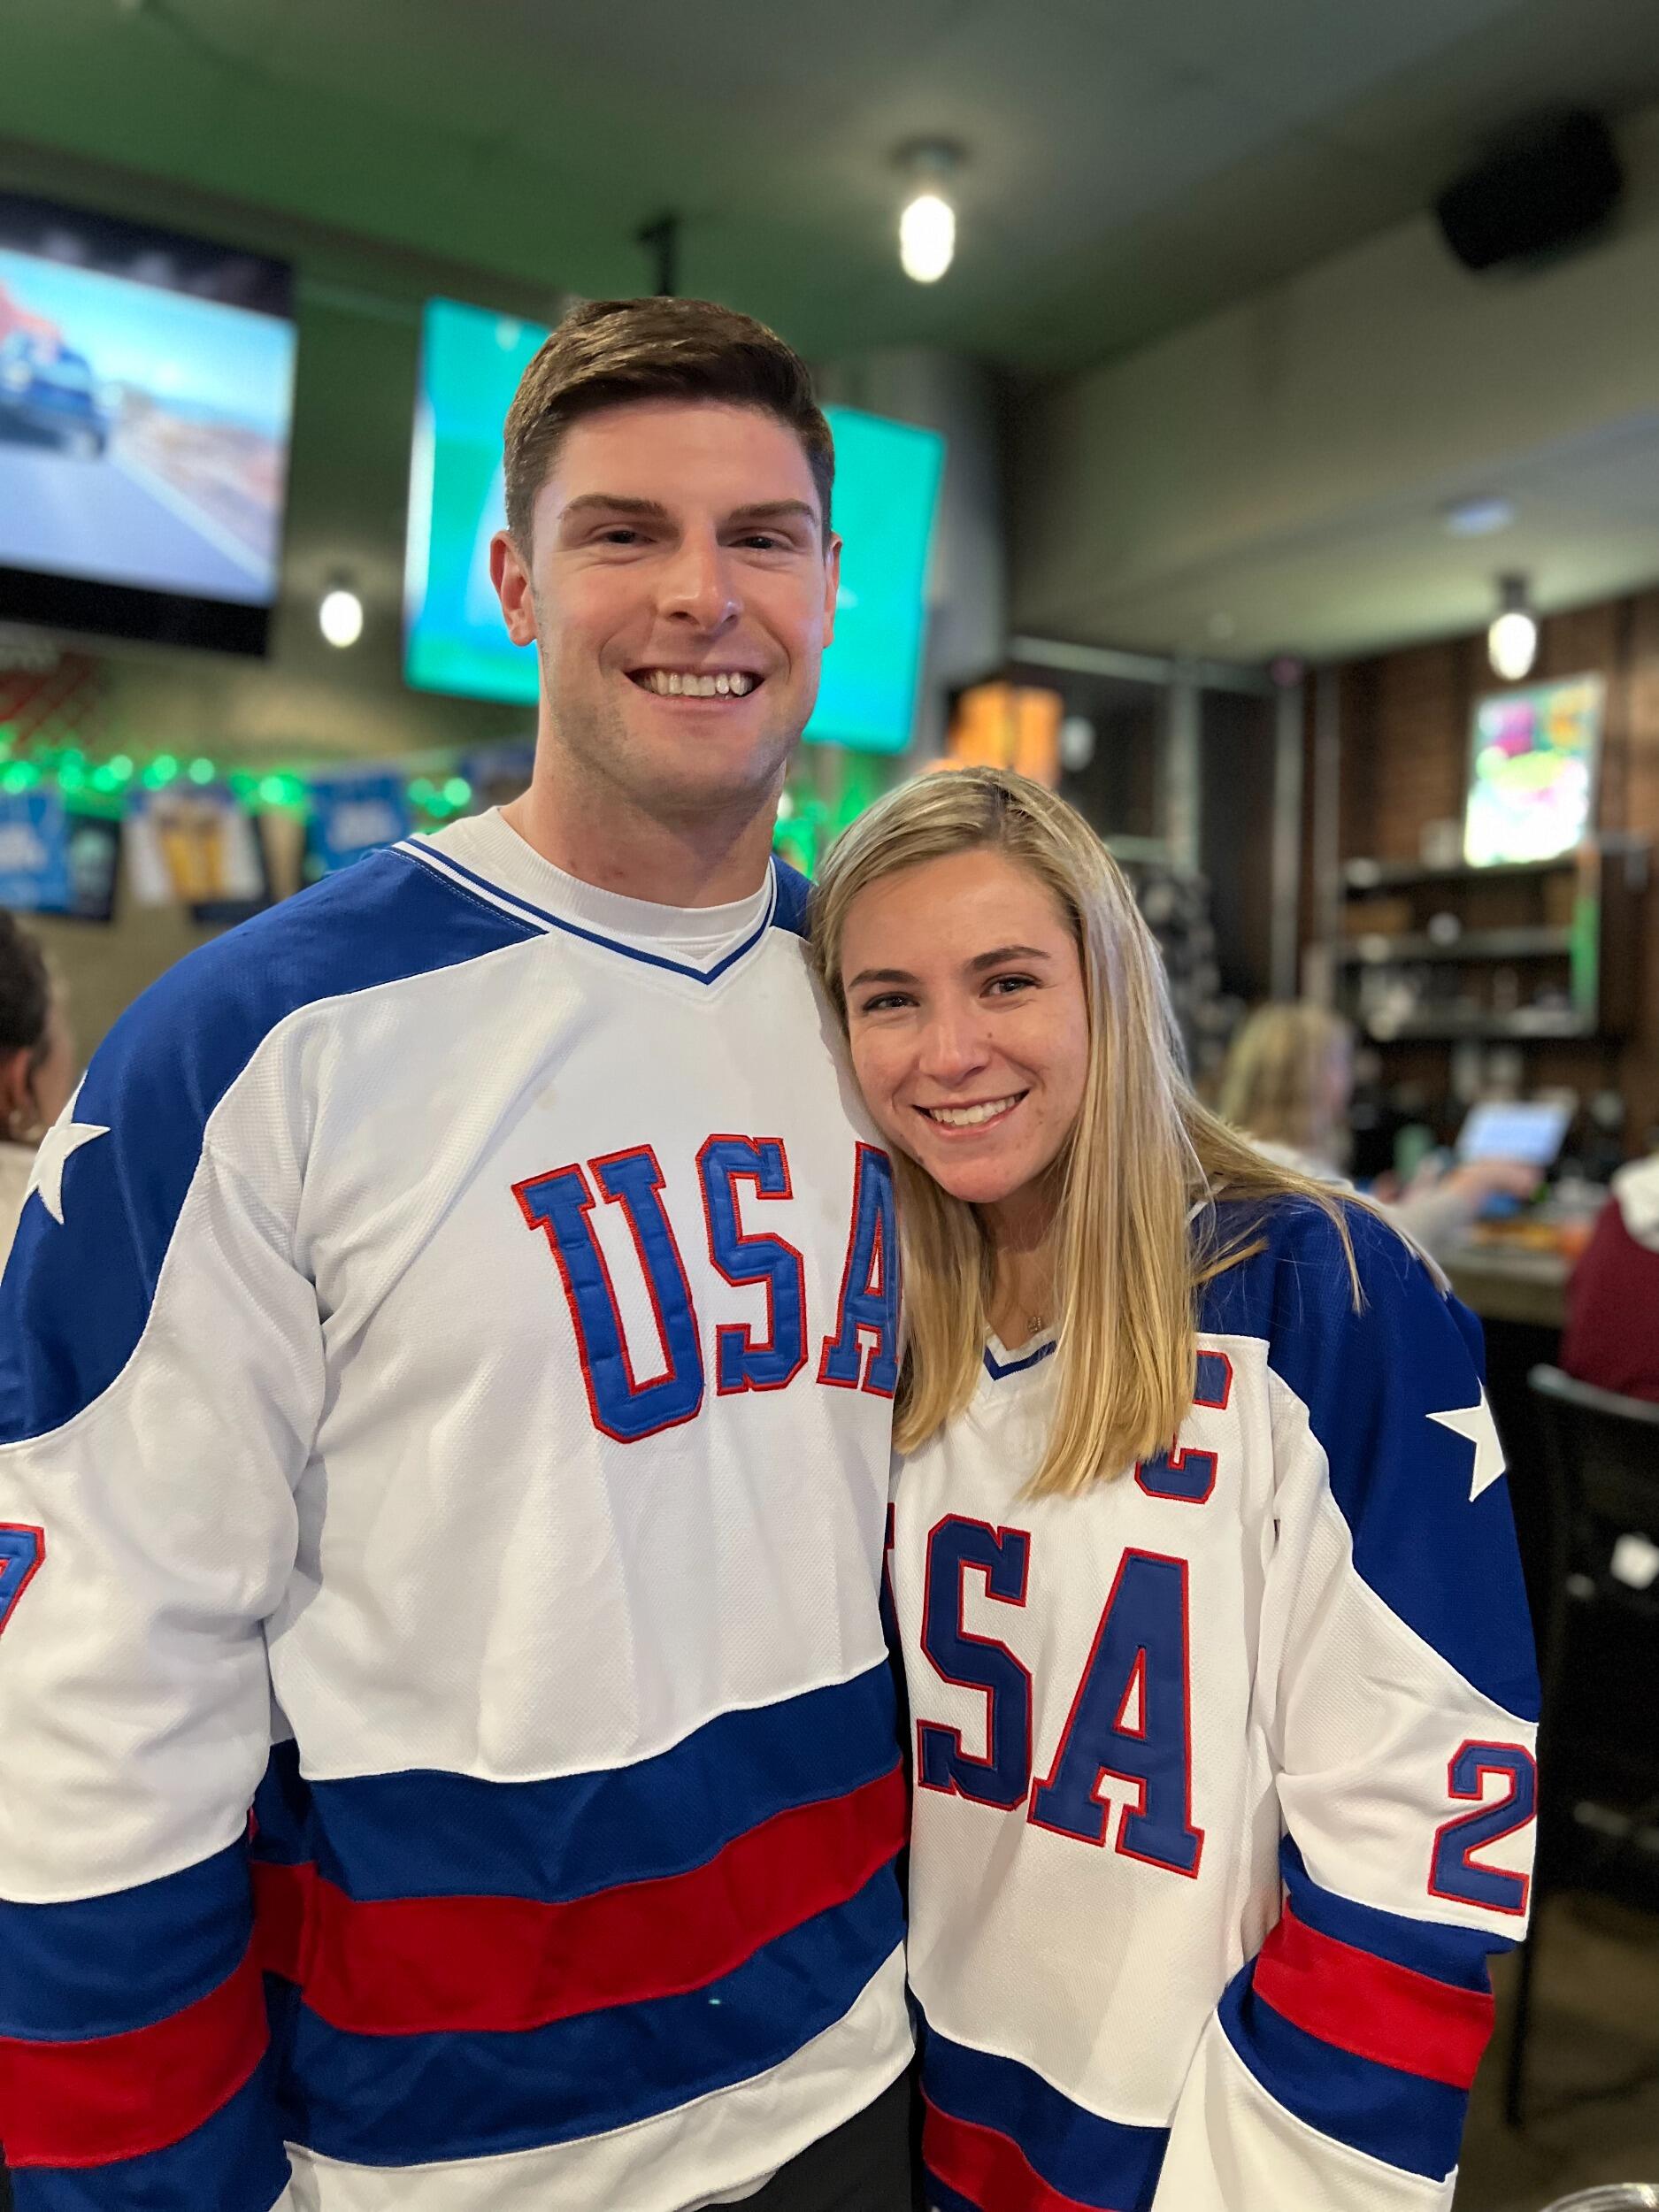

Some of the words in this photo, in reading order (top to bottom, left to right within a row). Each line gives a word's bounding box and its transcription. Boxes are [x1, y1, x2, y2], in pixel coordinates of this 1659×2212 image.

[511, 1133, 902, 1444] USA
[879, 1502, 1205, 1879] SA
[1427, 1739, 1538, 1916] 2
